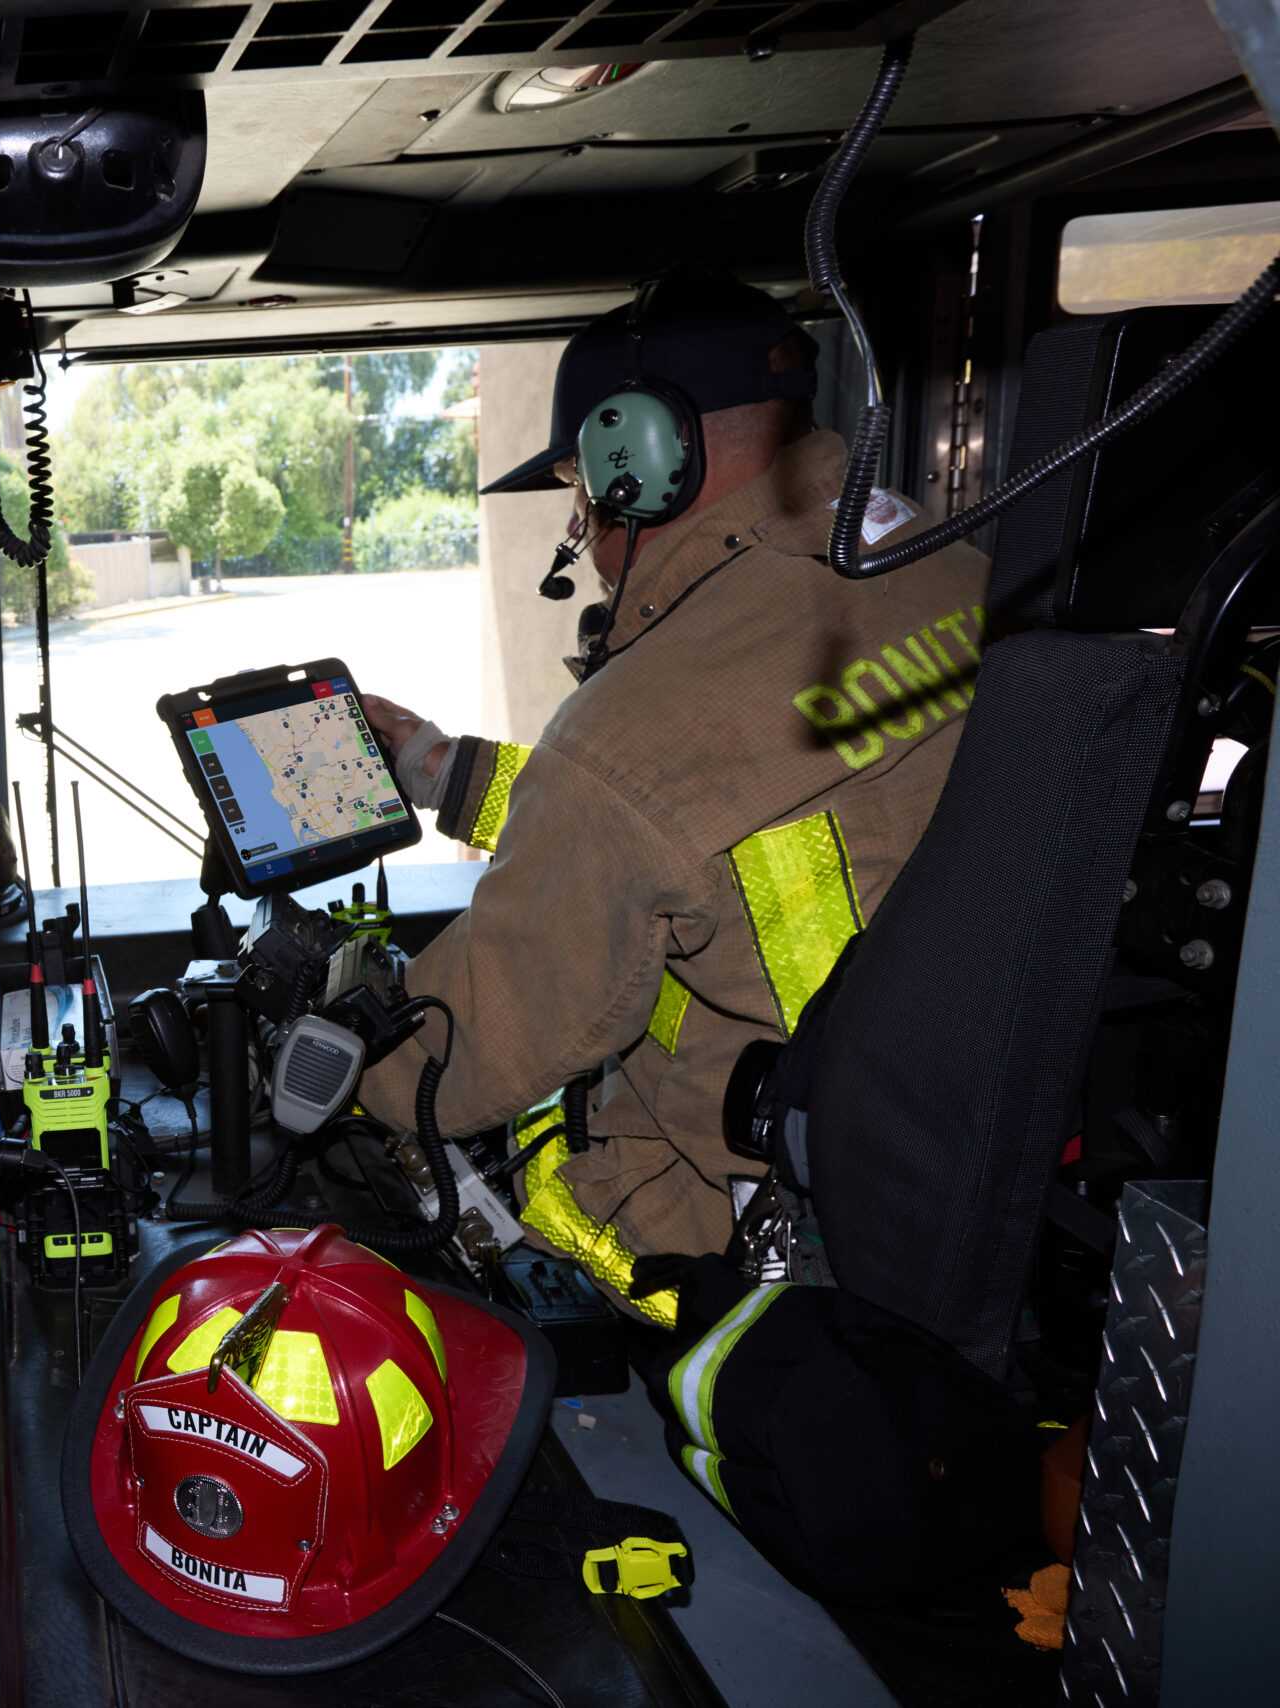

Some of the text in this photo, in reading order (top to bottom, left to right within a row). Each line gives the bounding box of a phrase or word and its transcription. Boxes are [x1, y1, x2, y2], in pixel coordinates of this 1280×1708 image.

[792, 605, 986, 769] BONIT
[53, 1089, 81, 1099] BKR 5000
[167, 1408, 268, 1459] CAPTAIN
[171, 1546, 247, 1592] BONITA
